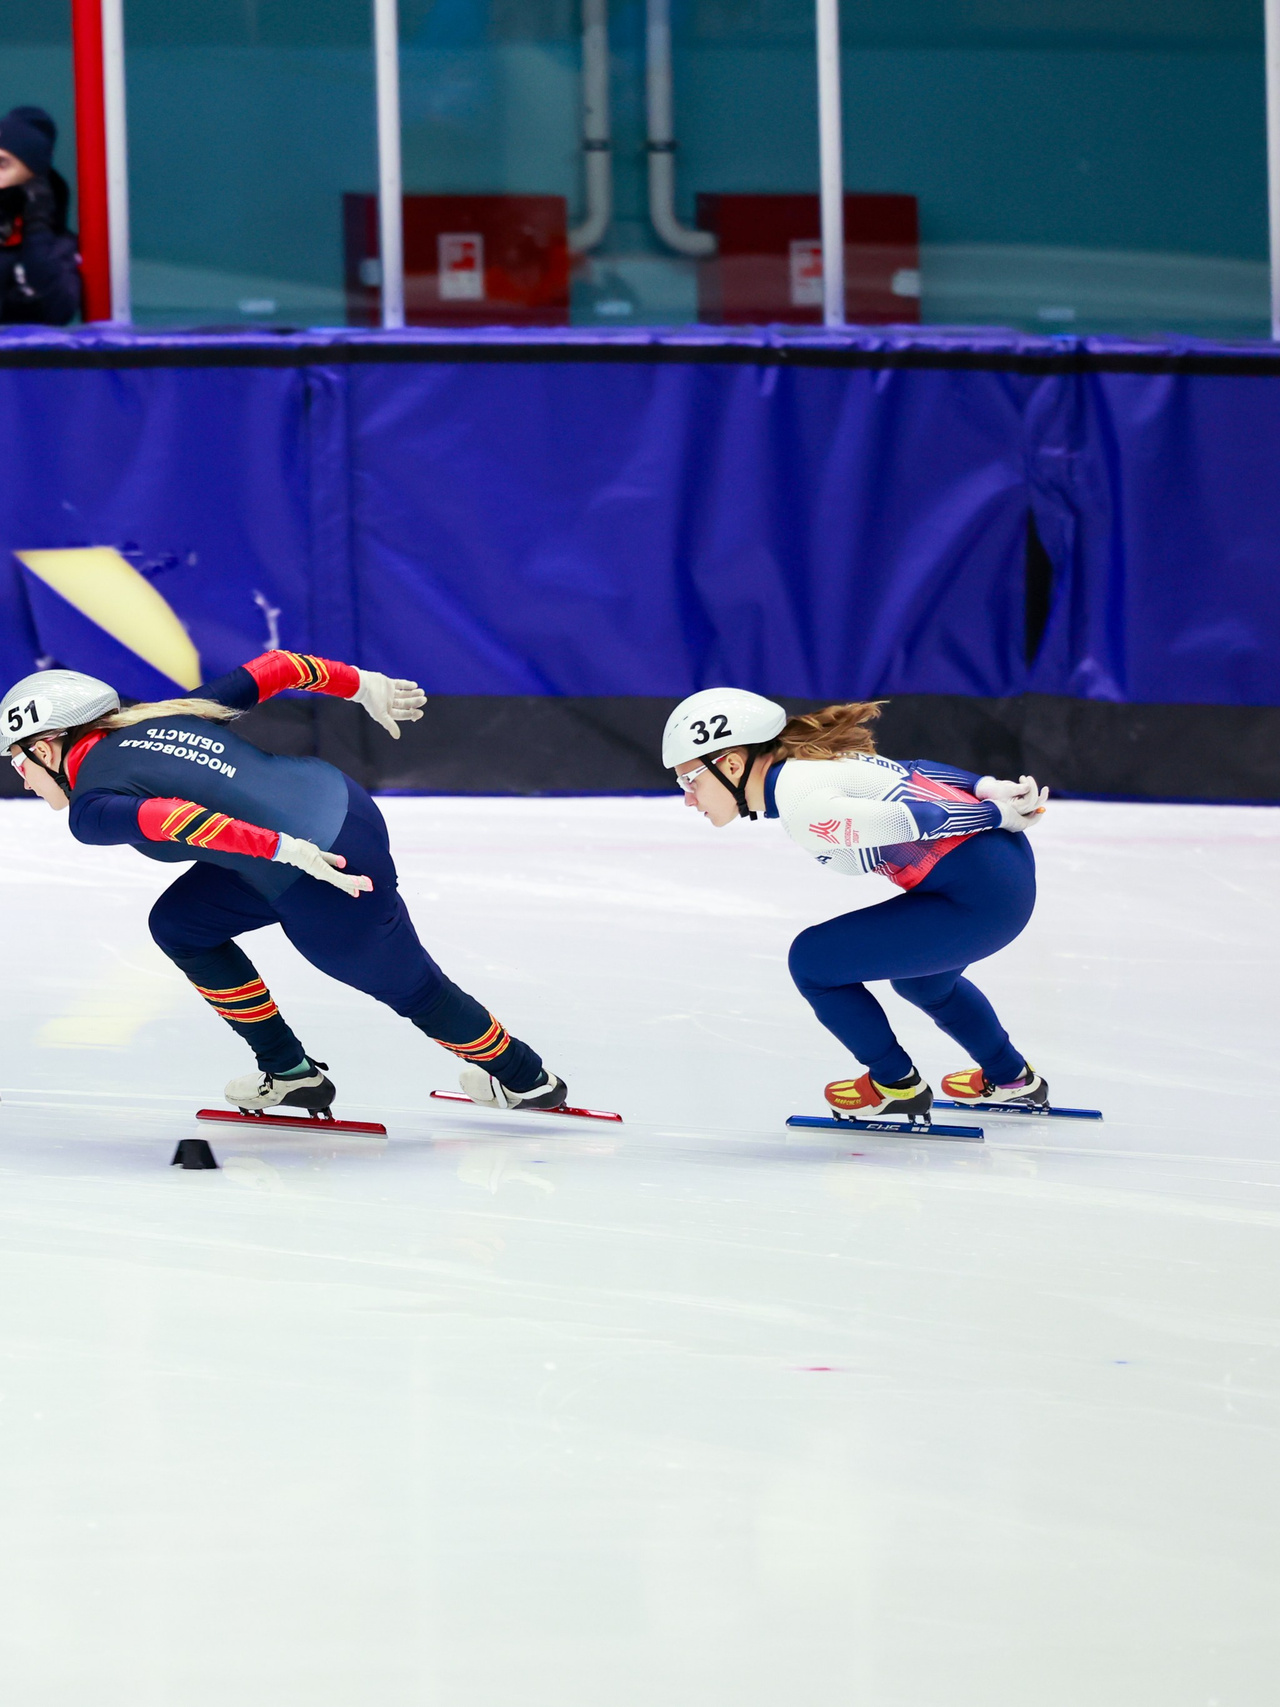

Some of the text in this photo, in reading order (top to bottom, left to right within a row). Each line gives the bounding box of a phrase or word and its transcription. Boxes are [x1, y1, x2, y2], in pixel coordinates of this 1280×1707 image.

[8, 699, 40, 732] 51
[689, 714, 733, 745] 32
[146, 728, 225, 754] ОБЛАСТЬ
[118, 739, 237, 779] МОСКОВСКАЯ
